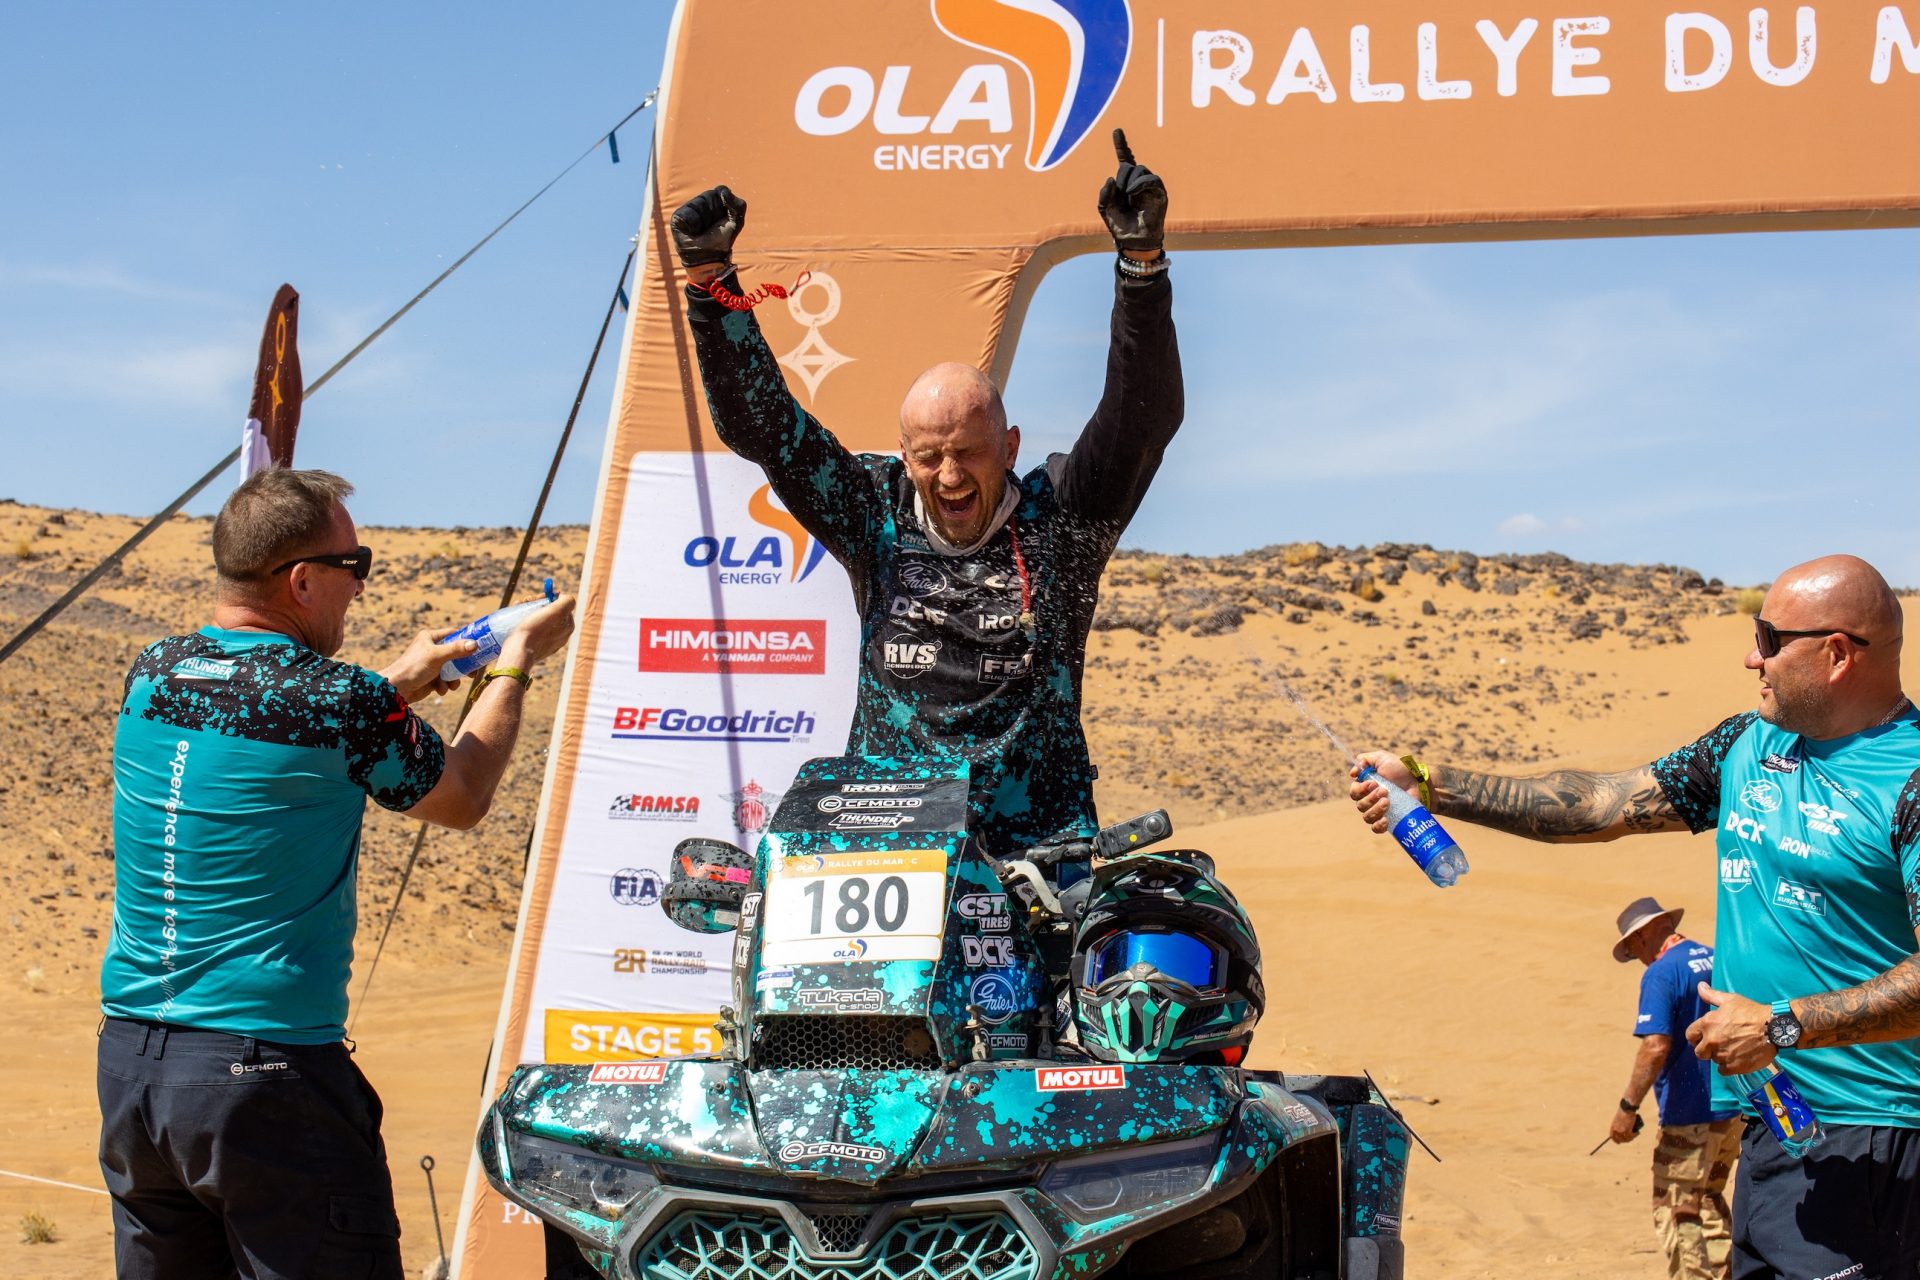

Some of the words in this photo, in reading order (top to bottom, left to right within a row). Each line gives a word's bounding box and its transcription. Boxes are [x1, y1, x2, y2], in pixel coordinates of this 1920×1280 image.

[1191, 17, 1610, 108] RALLYE
[1665, 6, 1816, 92] DU
[794, 64, 1013, 136] OLA
[873, 144, 1012, 171] ENERGY
[684, 536, 782, 568] OLA
[719, 572, 782, 585] ENERGY
[650, 630, 814, 650] HIMOINSA
[702, 654, 709, 662] A
[713, 653, 765, 662] YANMAR
[769, 653, 814, 663] COMPANY
[884, 643, 936, 664] RVS
[179, 659, 233, 679] THUNDER
[613, 707, 816, 734] BFGoodrich
[164, 740, 190, 846] experience
[843, 784, 899, 792] IRON
[630, 795, 700, 813] FRMSA
[845, 799, 919, 807] CFMOTO
[1799, 801, 1849, 820] CST
[840, 814, 900, 826] THUNDER
[1779, 836, 1811, 859] IRON
[162, 851, 176, 902] more
[1721, 857, 1750, 878] RVS
[1779, 882, 1821, 903] FRT
[804, 876, 909, 935] 180
[959, 897, 1006, 917] CST
[980, 917, 1010, 929] TIRES
[963, 938, 1013, 965] DCK
[651, 967, 708, 975] CHAMPIONSHIP
[570, 1024, 681, 1054] STAGE
[693, 1025, 712, 1054] 5
[991, 1036, 1026, 1045] CFMOTO
[245, 1062, 288, 1072] CFMOTO
[594, 1063, 663, 1080] MOTUL
[1043, 1068, 1119, 1086] MOTUL
[806, 1145, 884, 1156] CFMOTO
